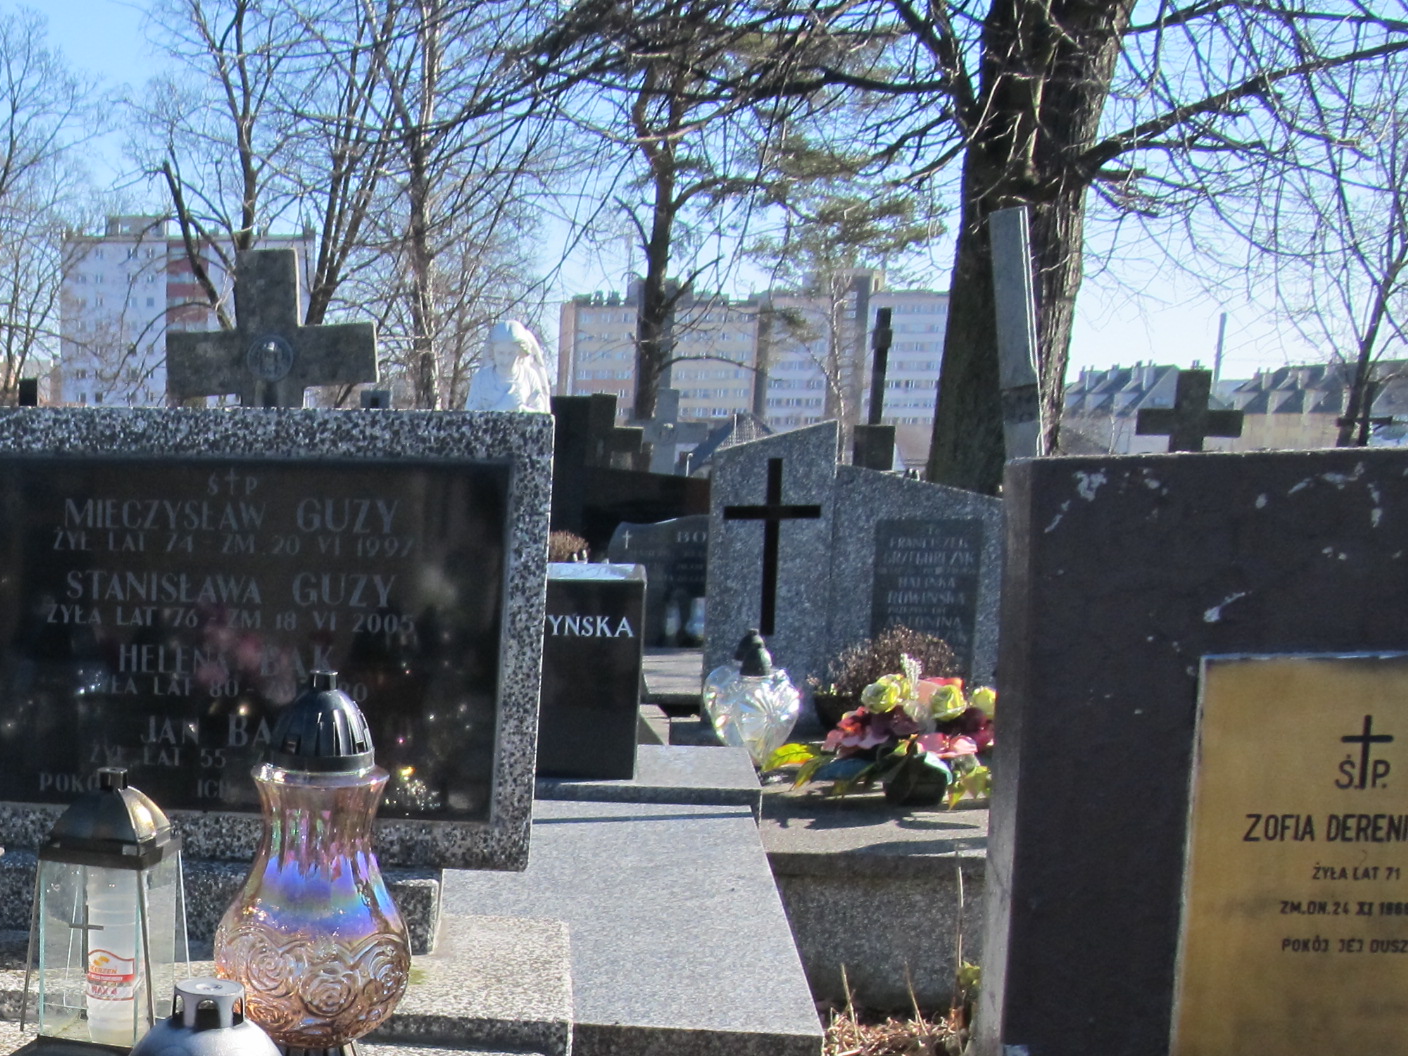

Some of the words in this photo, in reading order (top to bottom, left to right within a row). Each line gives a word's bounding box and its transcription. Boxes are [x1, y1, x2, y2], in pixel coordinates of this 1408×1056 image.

[64, 497, 267, 531] MIECZYSŁAW
[296, 497, 399, 534] GUZY
[108, 530, 147, 552] LAT
[66, 569, 262, 605] STANISŁAWA
[292, 571, 398, 608] GUZY
[116, 606, 158, 628] LAT
[352, 613, 416, 634] 2005
[140, 714, 201, 747] JAN
[200, 748, 227, 769] 55
[1242, 813, 1316, 843] ZOFIA
[1312, 861, 1349, 881] ŻYŁA
[1352, 865, 1381, 881] LAT
[1385, 865, 1402, 881] 71
[1281, 934, 1330, 953] POKÓJ
[1338, 938, 1365, 953] JEJ
